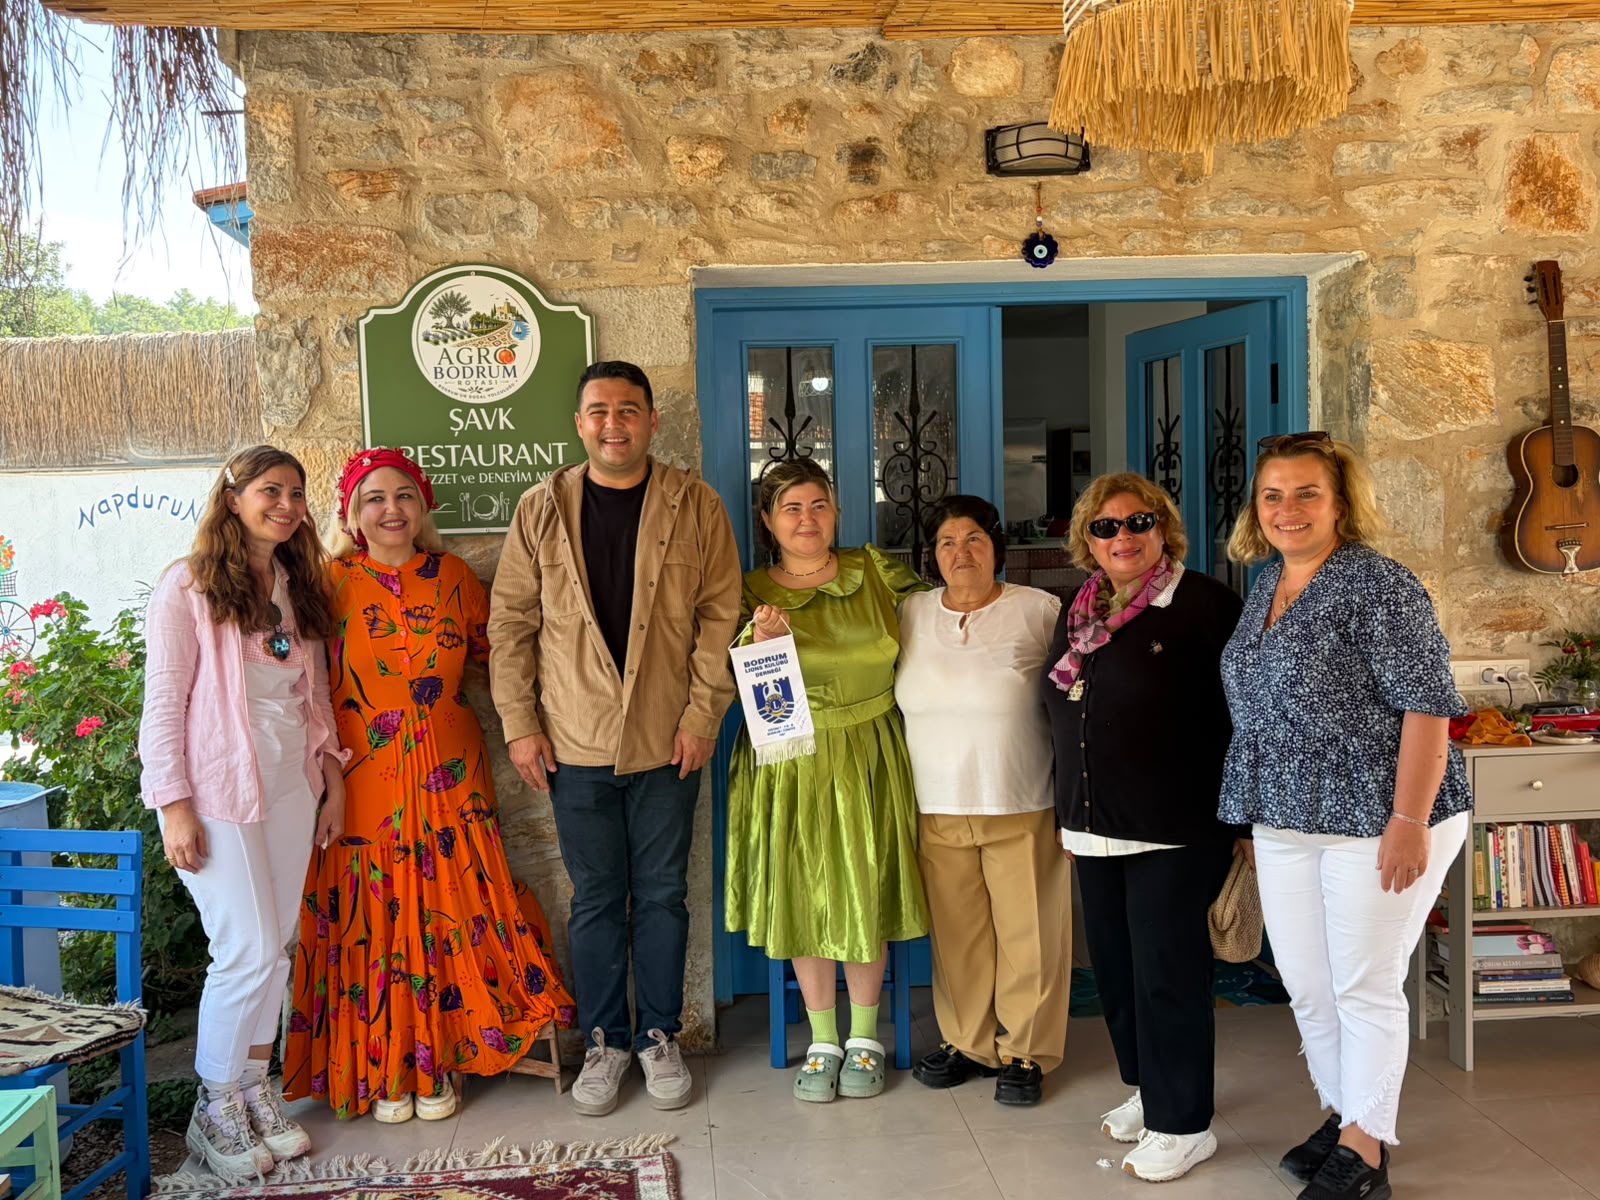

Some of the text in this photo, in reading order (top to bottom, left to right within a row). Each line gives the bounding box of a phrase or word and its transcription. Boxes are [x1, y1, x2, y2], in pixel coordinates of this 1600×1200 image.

[437, 347, 516, 365] AGRO
[433, 365, 517, 379] BODRUM
[449, 407, 515, 437] ŞAVK
[427, 473, 458, 485] ZZET
[461, 474, 475, 484] ve
[479, 470, 532, 484] DENEYİM
[744, 653, 787, 668] BODRUM
[744, 659, 789, 673] LIONS KULÜBÜ
[755, 667, 781, 678] DERNEĞİ
